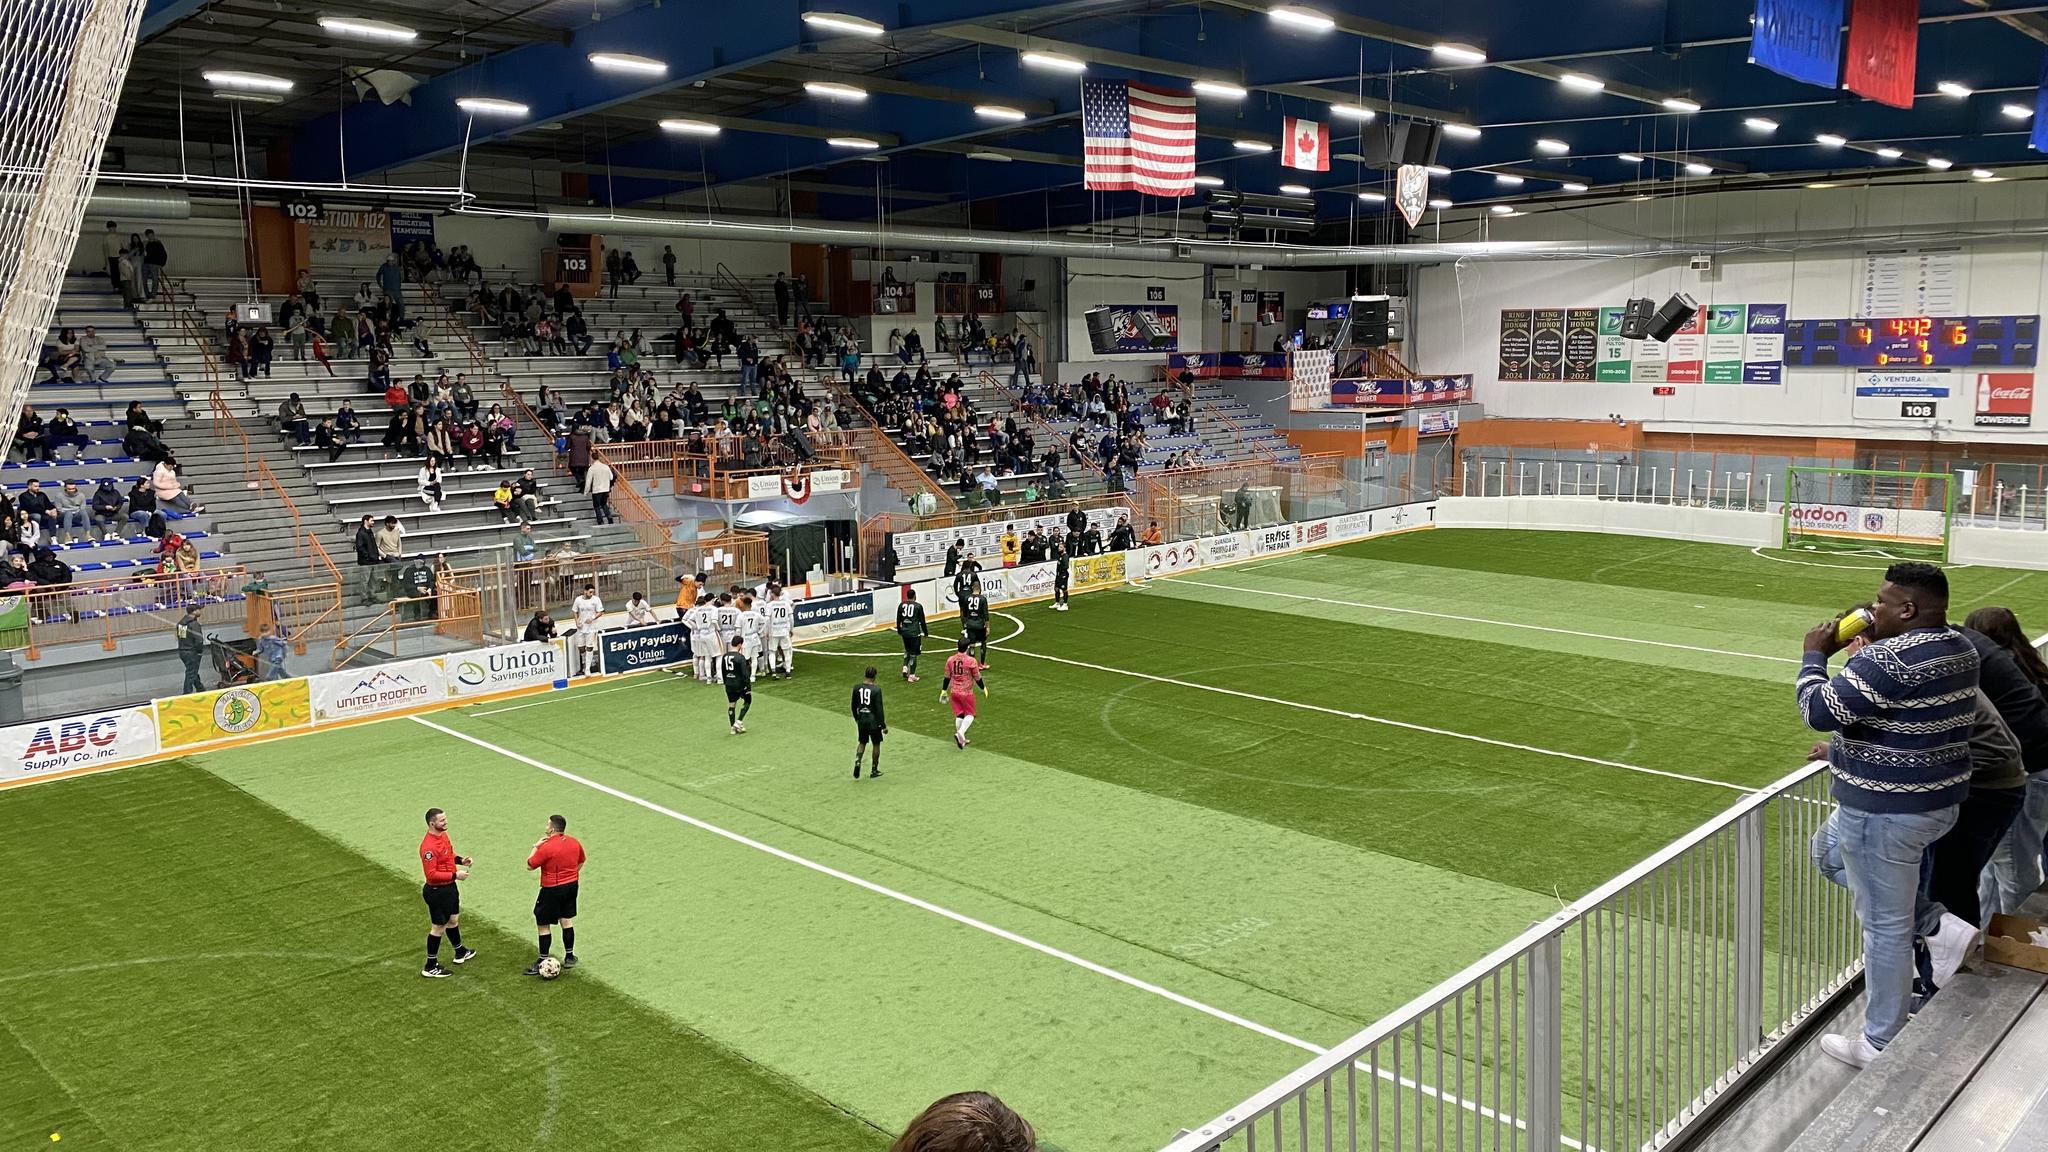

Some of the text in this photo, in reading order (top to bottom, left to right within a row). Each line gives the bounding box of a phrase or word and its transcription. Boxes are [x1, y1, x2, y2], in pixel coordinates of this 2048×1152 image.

[287, 204, 317, 217] 102
[364, 214, 385, 228] 102
[564, 258, 586, 270] 103
[885, 287, 903, 296] 104
[978, 290, 993, 299] 105
[1150, 292, 1163, 300] 106
[1243, 294, 1254, 302] 107
[1890, 319, 1932, 336] 4:42
[1858, 328, 1872, 344] 4
[1953, 326, 1967, 344] 6
[1918, 340, 1928, 352] 4
[1609, 348, 1621, 358] 15
[1879, 354, 1888, 365] 0
[1924, 354, 1932, 364] 0
[1242, 368, 1262, 376] CORNER
[1432, 392, 1445, 400] CORNER
[1991, 388, 2031, 399] Coca-Cola
[1906, 406, 1931, 416] 108
[1976, 416, 2029, 424] POWERADE
[821, 474, 839, 482] Union
[1779, 505, 1847, 522] Gordon
[1232, 543, 1240, 552] ART
[1266, 541, 1290, 552] THE PAIN
[1076, 565, 1088, 573] YOU
[962, 574, 972, 586] 14
[983, 578, 1002, 590] ion
[1021, 584, 1040, 592] UNITED
[1041, 580, 1056, 589] ROOF
[968, 597, 980, 610] 29
[774, 608, 786, 618] 70
[798, 602, 868, 620] two days earlier.
[902, 604, 914, 617] 30
[702, 613, 707, 623] 2
[722, 614, 732, 625] 21
[748, 618, 754, 628] 7
[829, 622, 846, 630] Union
[610, 639, 638, 652] Early
[638, 649, 664, 659] Union
[489, 650, 554, 672] Union
[724, 655, 734, 671] 15
[492, 665, 554, 682] Savings Bank
[953, 661, 963, 675] 16
[337, 685, 427, 708] UNITED ROOFING
[859, 688, 871, 705] 19
[377, 698, 412, 708] SOLUTIONS
[18, 715, 122, 760] ABC
[24, 748, 118, 771] Supply Co. inc.
